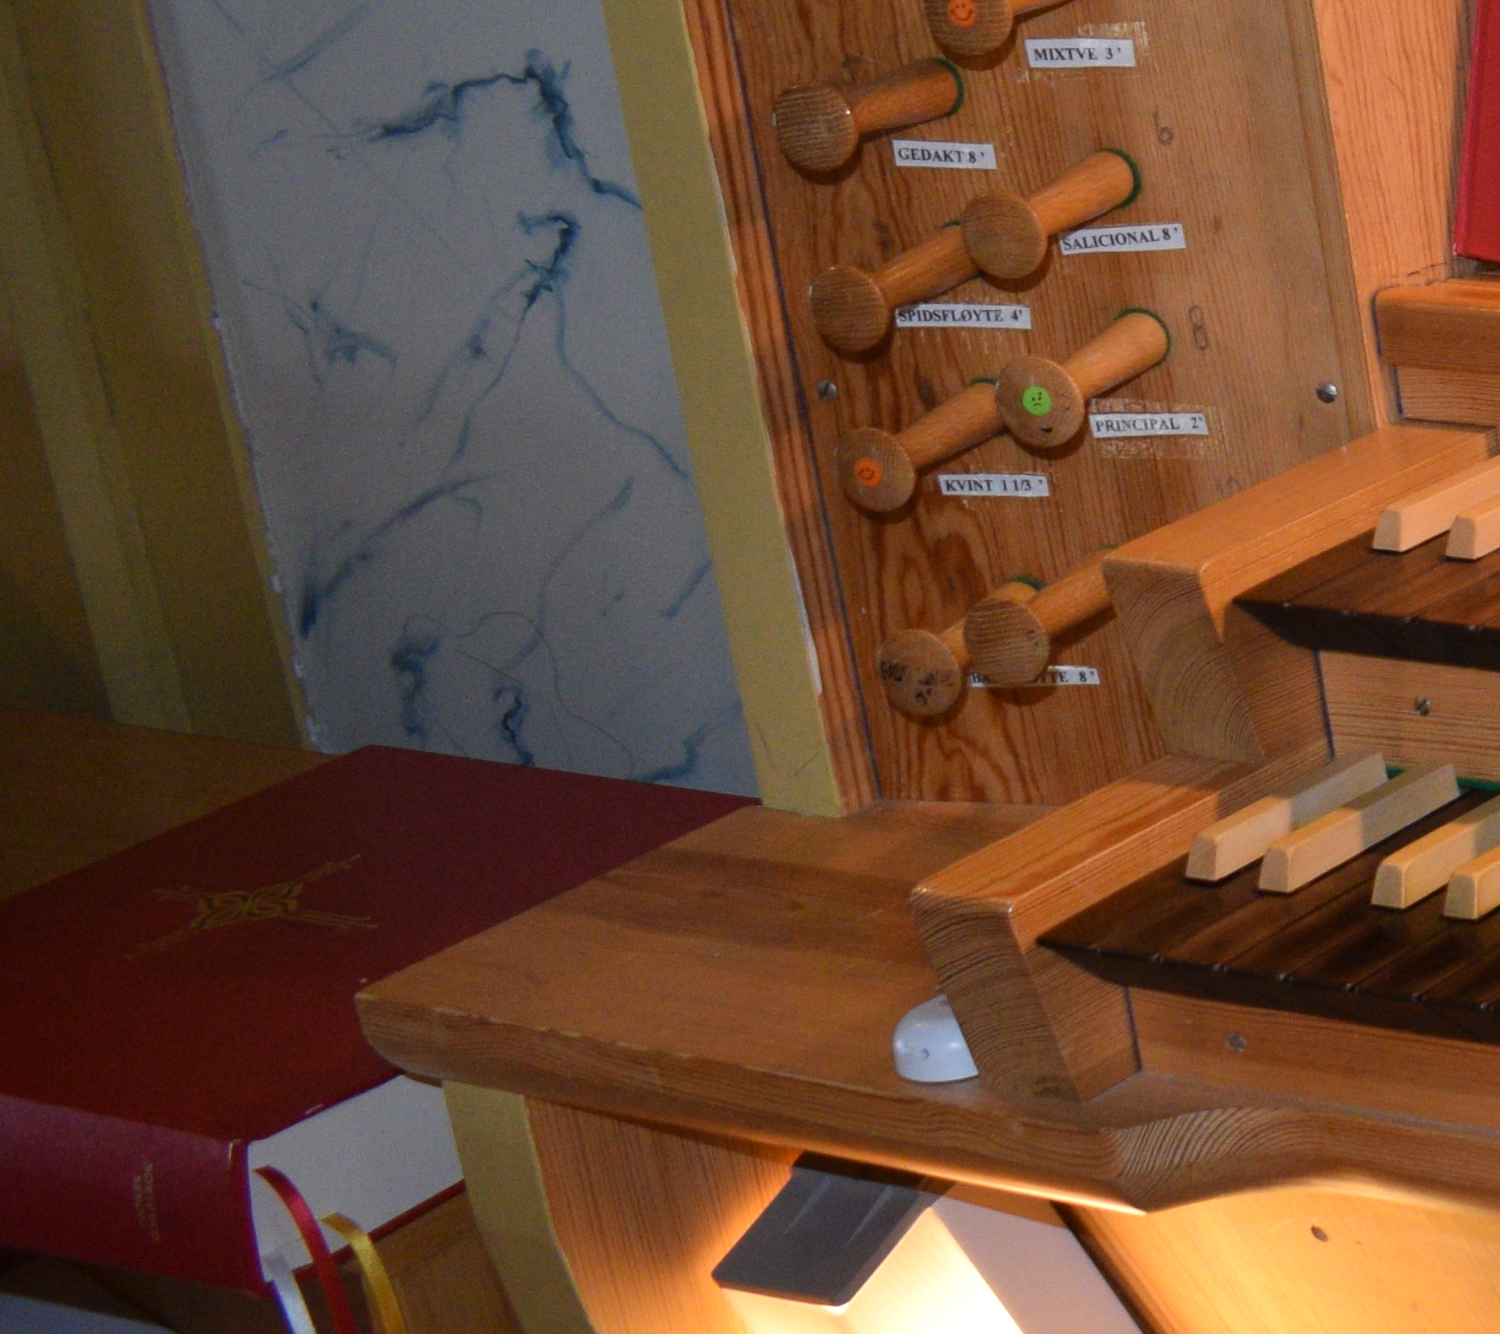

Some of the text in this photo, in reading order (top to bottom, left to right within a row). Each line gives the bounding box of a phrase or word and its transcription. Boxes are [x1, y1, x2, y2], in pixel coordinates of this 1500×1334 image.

[898, 147, 964, 163] GEDAKT
[1062, 229, 1160, 251] SALICIONAL
[1096, 417, 1180, 433] PRINCIPAL
[945, 478, 993, 492] KVINT
